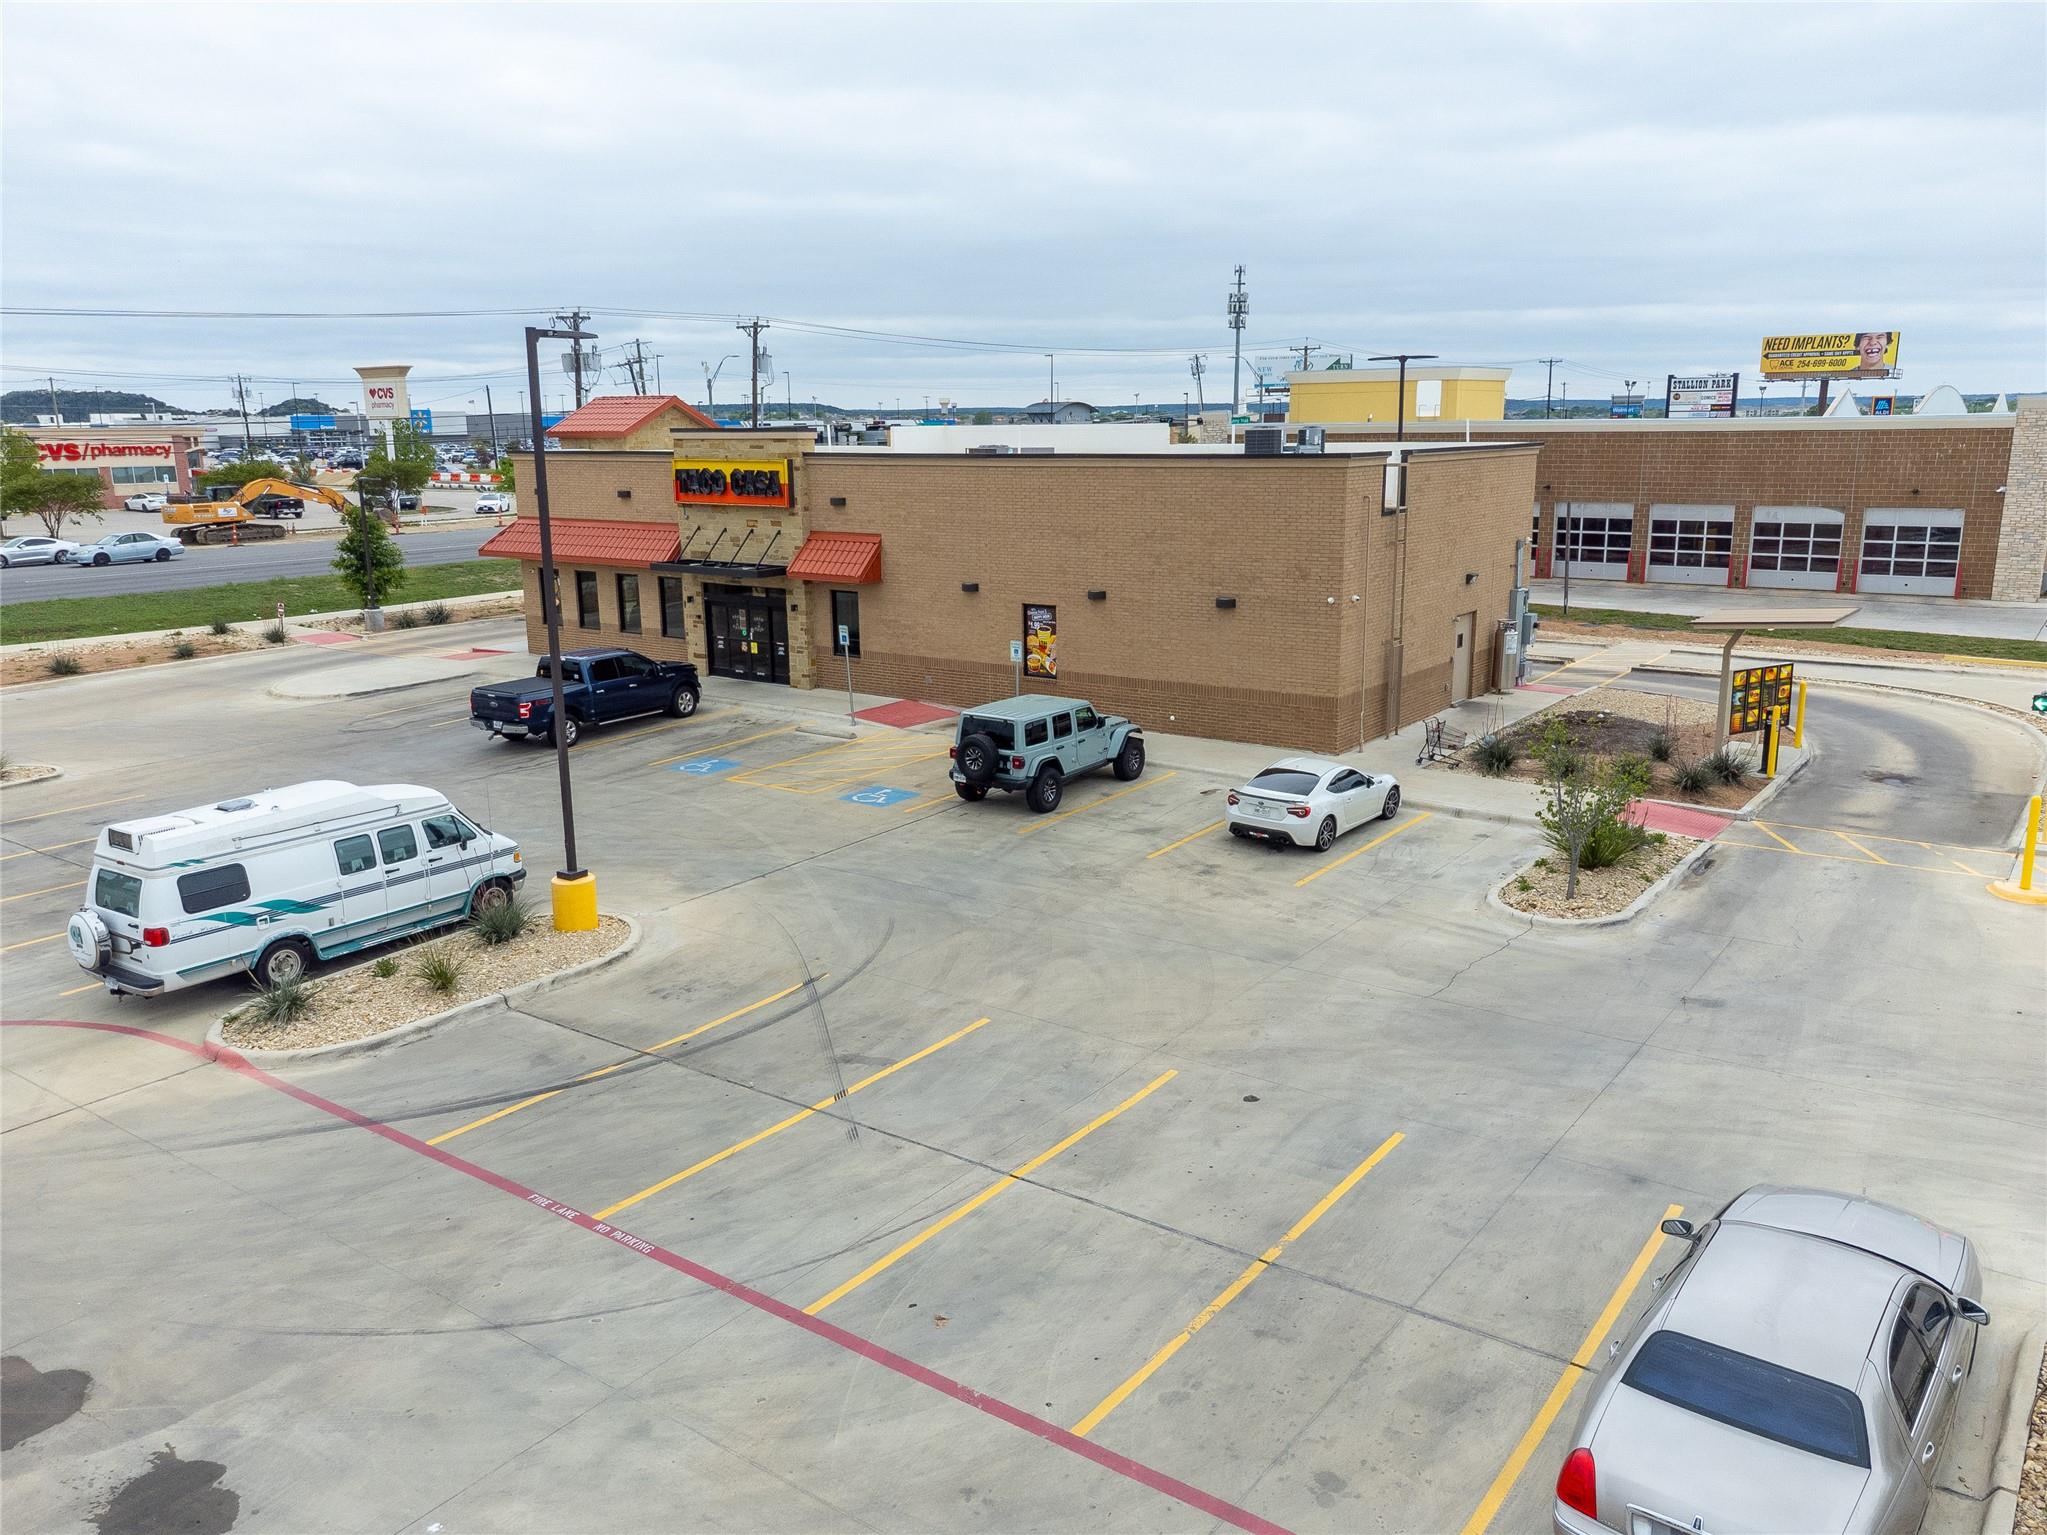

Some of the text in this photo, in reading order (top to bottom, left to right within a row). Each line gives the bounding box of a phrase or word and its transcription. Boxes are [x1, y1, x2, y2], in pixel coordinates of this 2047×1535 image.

[1764, 335, 1850, 351] NEED IMPLANTS?
[1779, 358, 1847, 368] ACE 254-699-6000
[1672, 379, 1732, 390] STALLION PARK
[377, 387, 394, 400] CVS
[371, 401, 394, 410] pharmacy
[675, 468, 783, 496] TACO CASA
[527, 1193, 655, 1254] FIRE LANE NO PARKING
